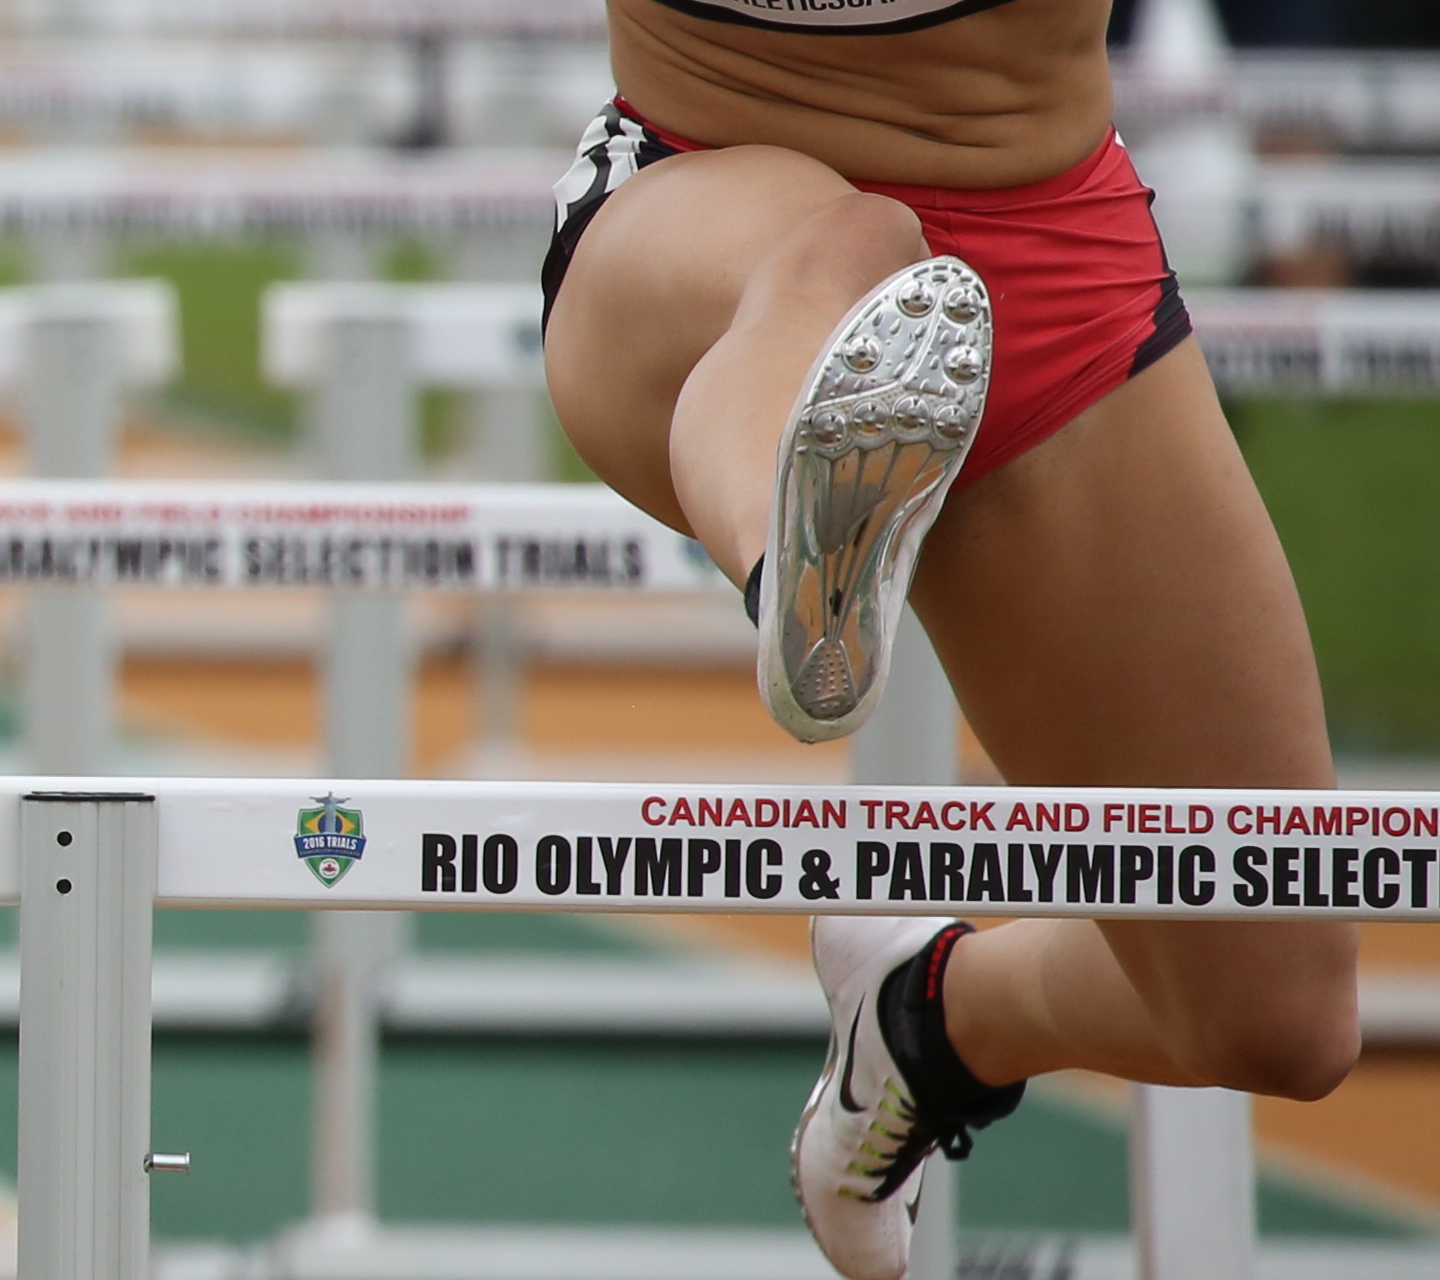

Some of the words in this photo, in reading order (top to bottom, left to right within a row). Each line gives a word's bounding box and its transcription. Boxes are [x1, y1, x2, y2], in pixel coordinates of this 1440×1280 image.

[245, 535, 474, 584] SELECTION
[496, 535, 643, 585] TRIALS
[641, 796, 846, 827] CANADIAN
[860, 800, 995, 830] TRACK
[1007, 802, 1089, 832] AND
[1104, 804, 1213, 834] FIELD
[326, 836, 358, 850] TRIALS
[421, 833, 518, 894] RIO
[535, 835, 783, 899] OLYMPIC
[799, 849, 840, 900] &
[856, 841, 1215, 906] PARALYMPIC
